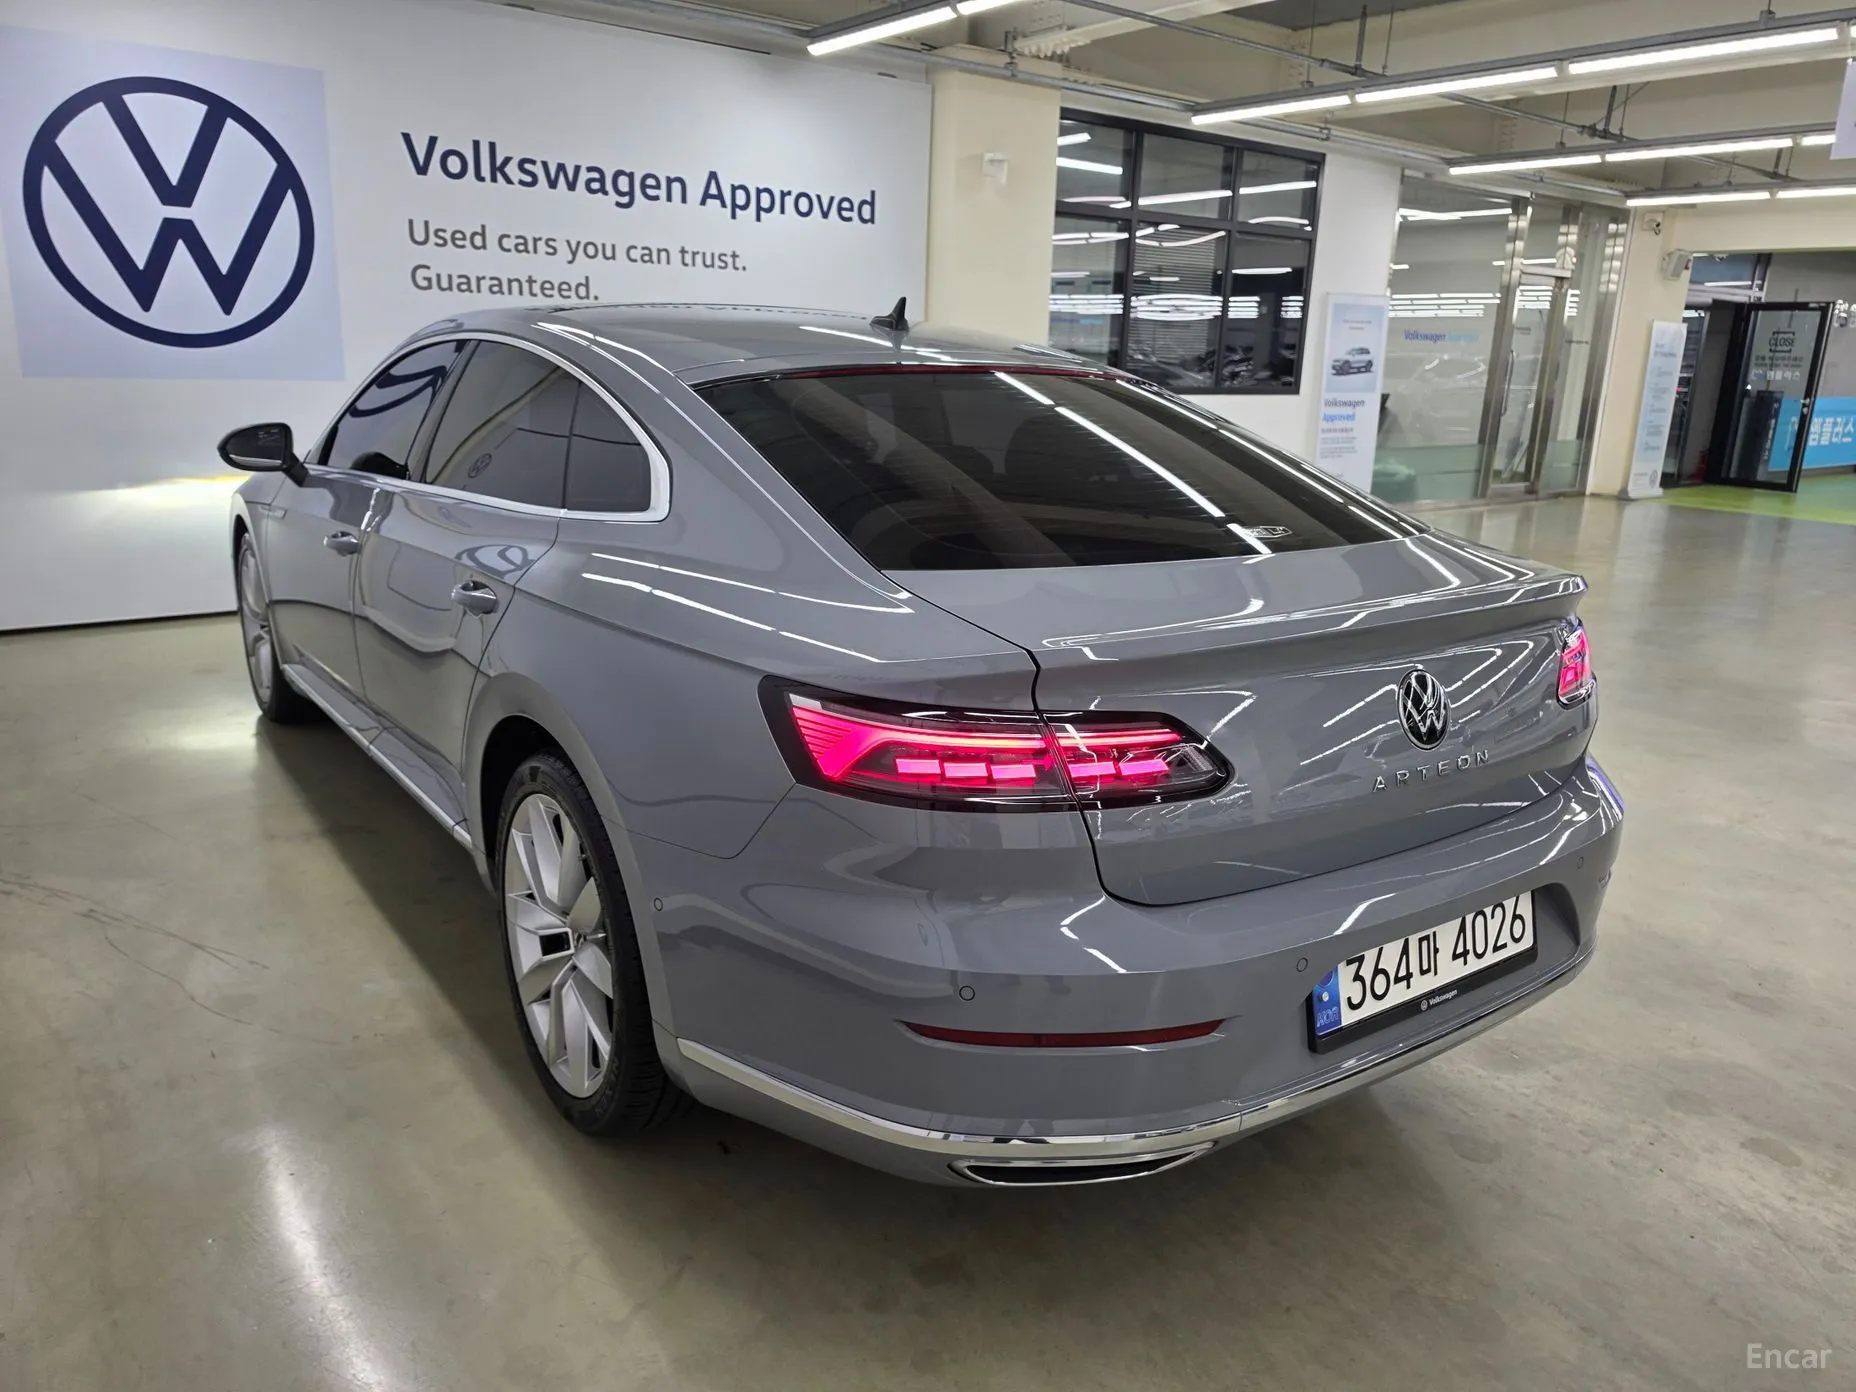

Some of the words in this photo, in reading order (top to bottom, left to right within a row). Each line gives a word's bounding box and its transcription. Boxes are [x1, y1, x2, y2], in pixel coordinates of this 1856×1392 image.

[401, 131, 688, 209] Volkswagen
[699, 170, 877, 225] Approved
[407, 218, 488, 252] Used
[497, 227, 558, 256] cars
[565, 237, 617, 264] you
[625, 240, 671, 266] can
[678, 246, 748, 272] trust.
[410, 263, 600, 301] Guaranteed.
[1404, 328, 1446, 344] Volkswagen
[1769, 336, 1796, 348] CLOSE
[1324, 398, 1365, 409] Volkswagen
[1322, 412, 1356, 423] Approved
[1372, 750, 1489, 793] ARTEON
[1345, 930, 1440, 1011] 364마
[1451, 895, 1526, 966] 4026
[1428, 989, 1458, 1006] Volkswagen
